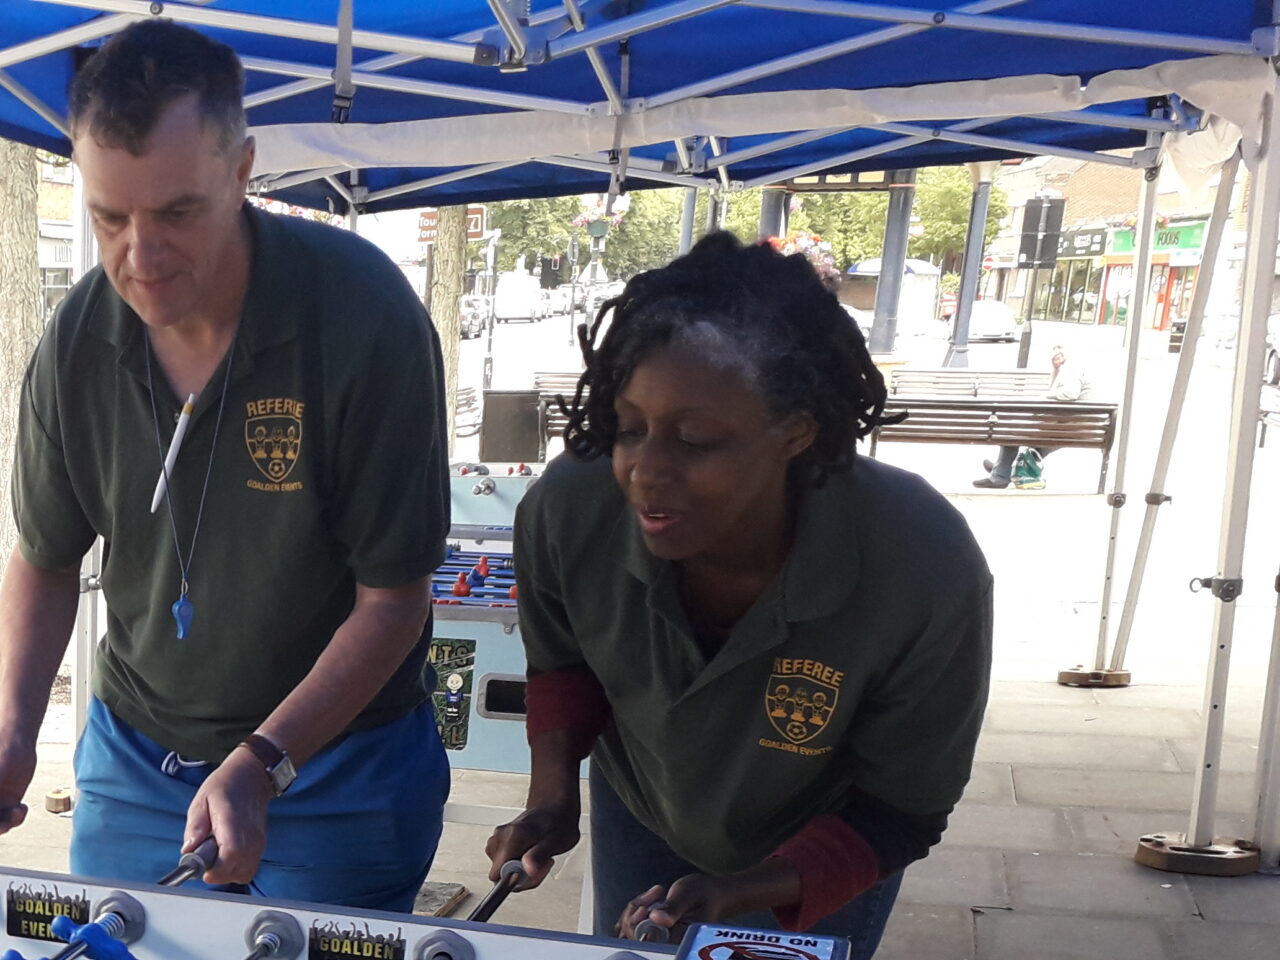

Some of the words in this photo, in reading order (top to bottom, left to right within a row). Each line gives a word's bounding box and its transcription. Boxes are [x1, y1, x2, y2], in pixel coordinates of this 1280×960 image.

[419, 217, 437, 227] Tou
[426, 645, 469, 667] NTS
[16, 898, 80, 920] GOALDEN
[21, 920, 56, 939] EVEN
[715, 930, 782, 944] DRINK
[319, 936, 394, 960] GOALDEN
[788, 938, 818, 948] NO
